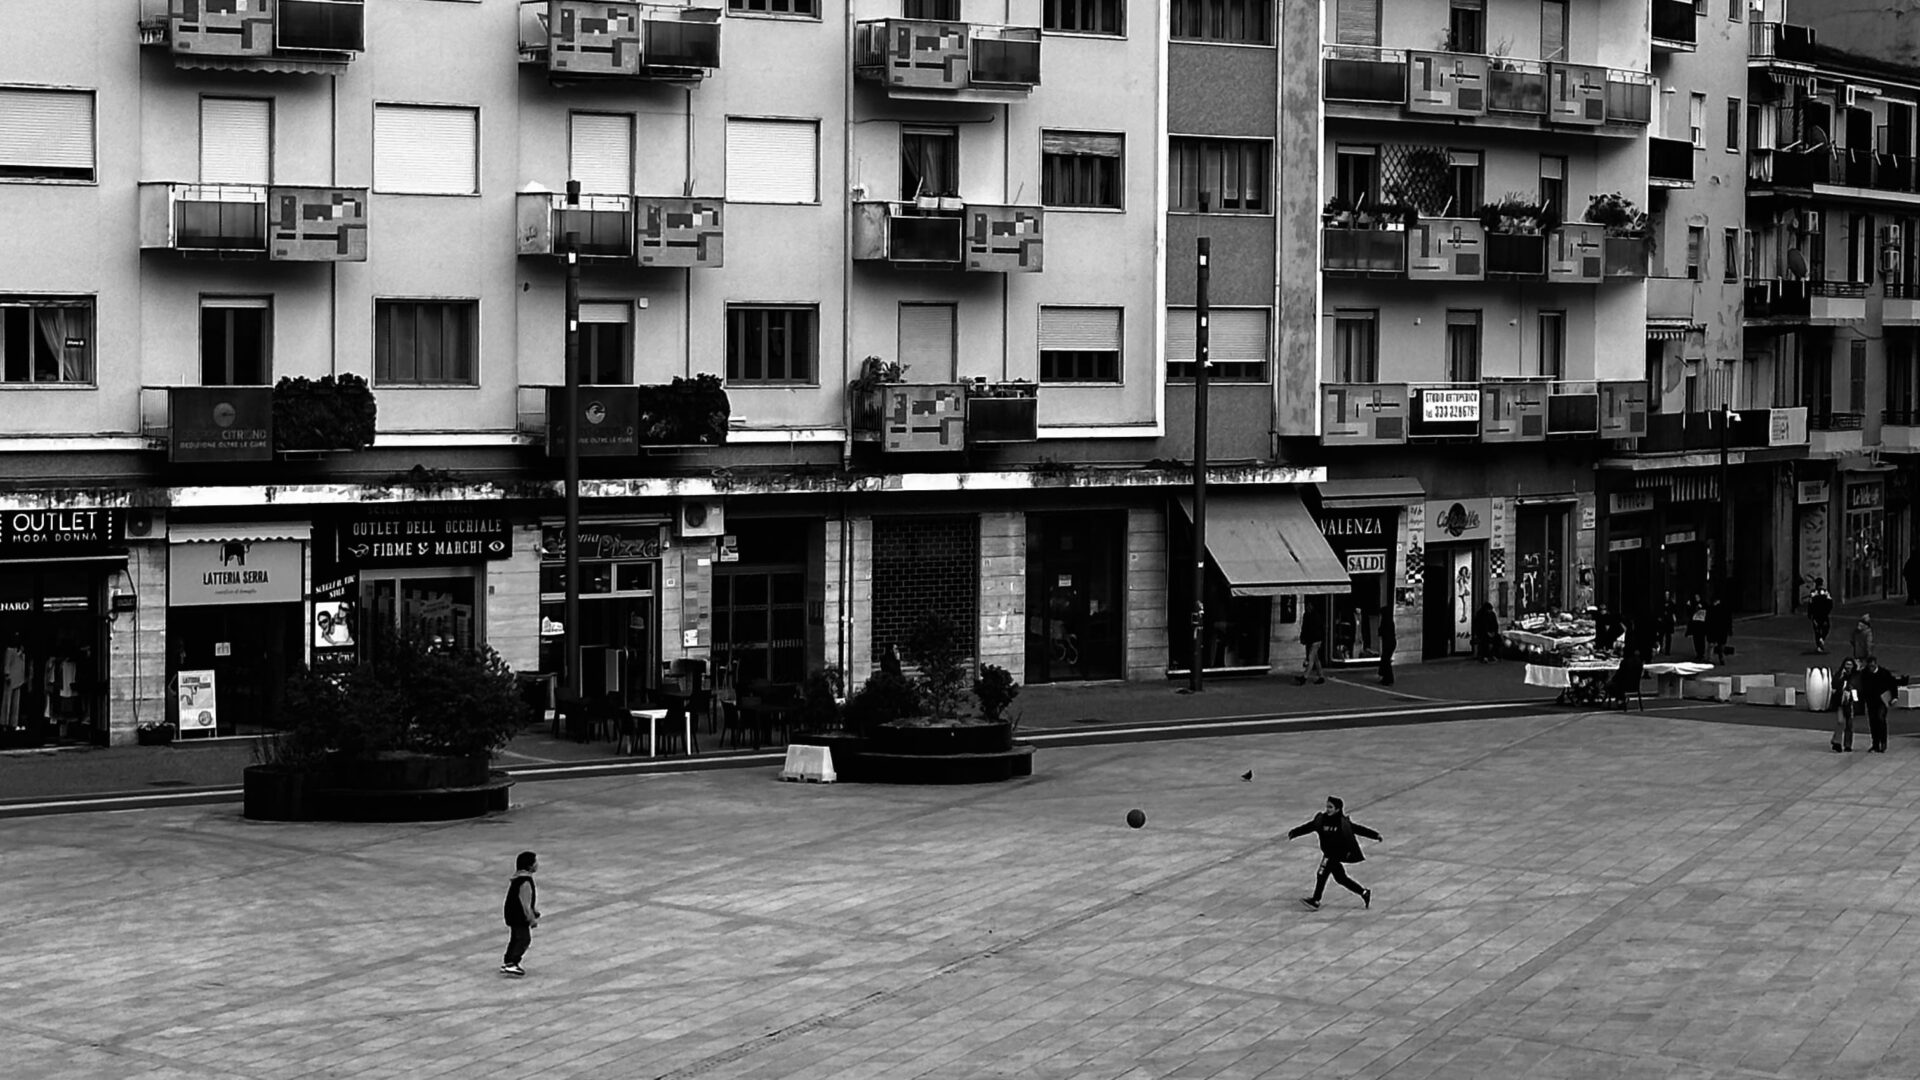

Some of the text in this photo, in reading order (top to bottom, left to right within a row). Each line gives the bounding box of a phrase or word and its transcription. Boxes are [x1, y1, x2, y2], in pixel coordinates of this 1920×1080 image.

[13, 511, 98, 532] OUTLET
[353, 521, 400, 536] OUTLET
[445, 519, 502, 534] OCCHIALE
[1320, 518, 1382, 535] VALENZA
[13, 532, 97, 543] MODA DONNA
[373, 541, 413, 557] FIRME
[435, 540, 483, 555] MARCHI
[1348, 556, 1384, 571] SALDI
[203, 570, 269, 585] LATTERIA SERRA
